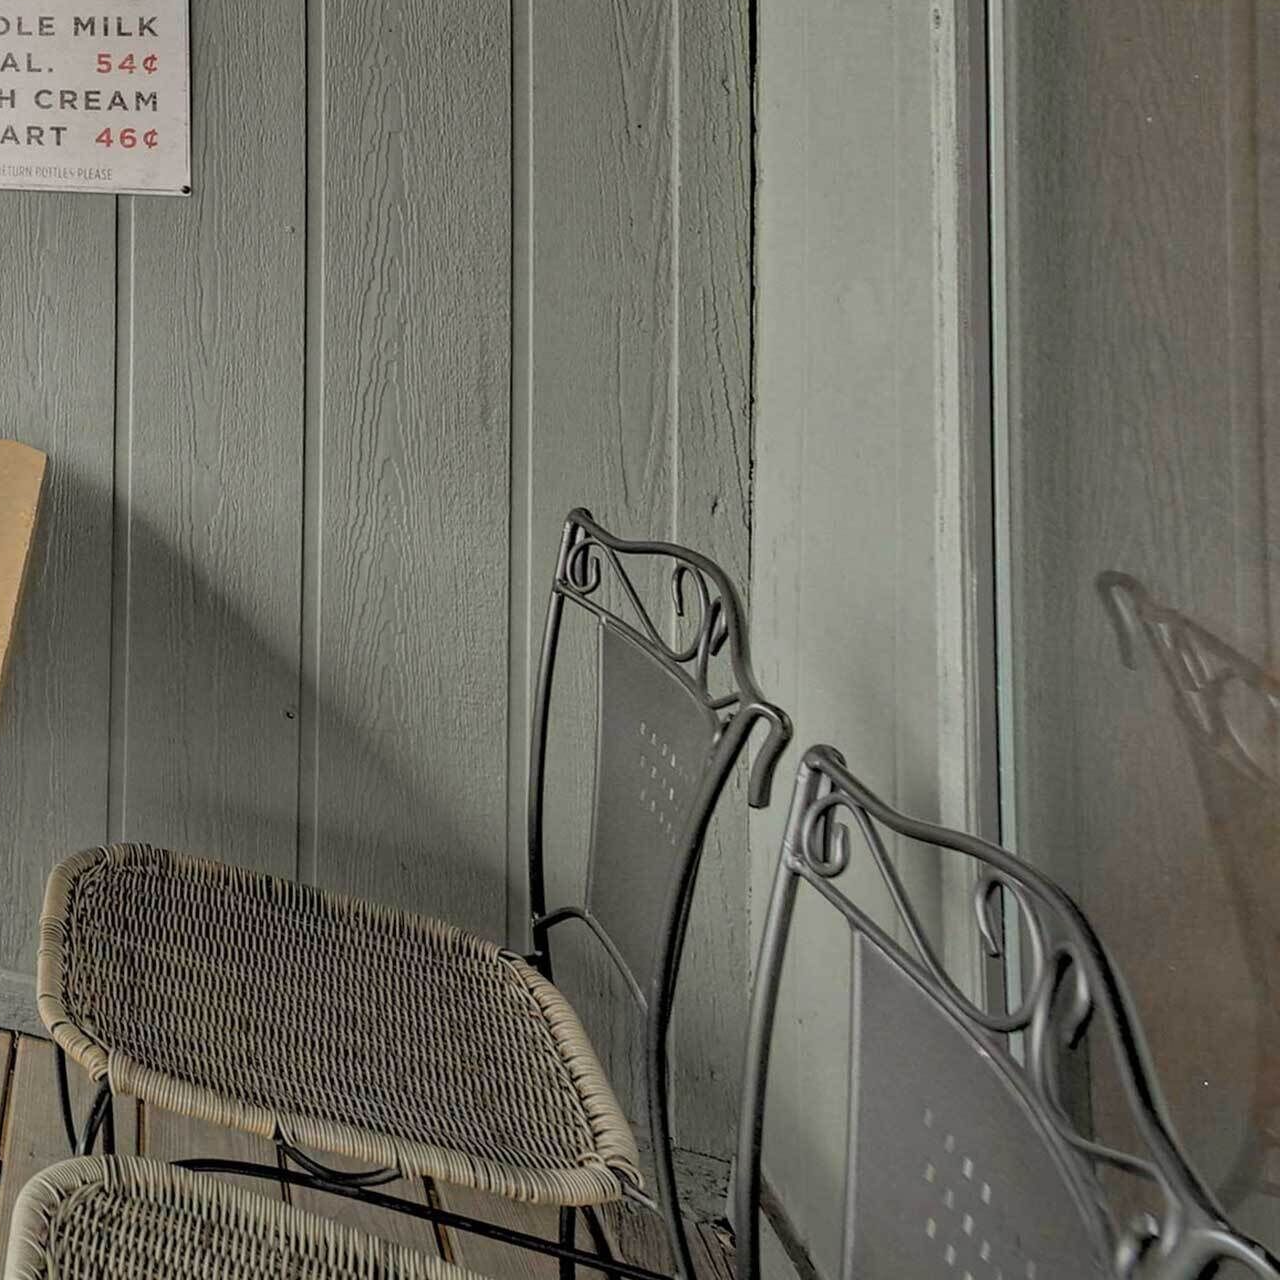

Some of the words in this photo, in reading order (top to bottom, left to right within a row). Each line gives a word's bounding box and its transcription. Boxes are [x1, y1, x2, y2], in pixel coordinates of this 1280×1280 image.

[73, 16, 159, 37] MILK
[34, 89, 158, 112] CREAM
[78, 167, 112, 180] PLEASE
